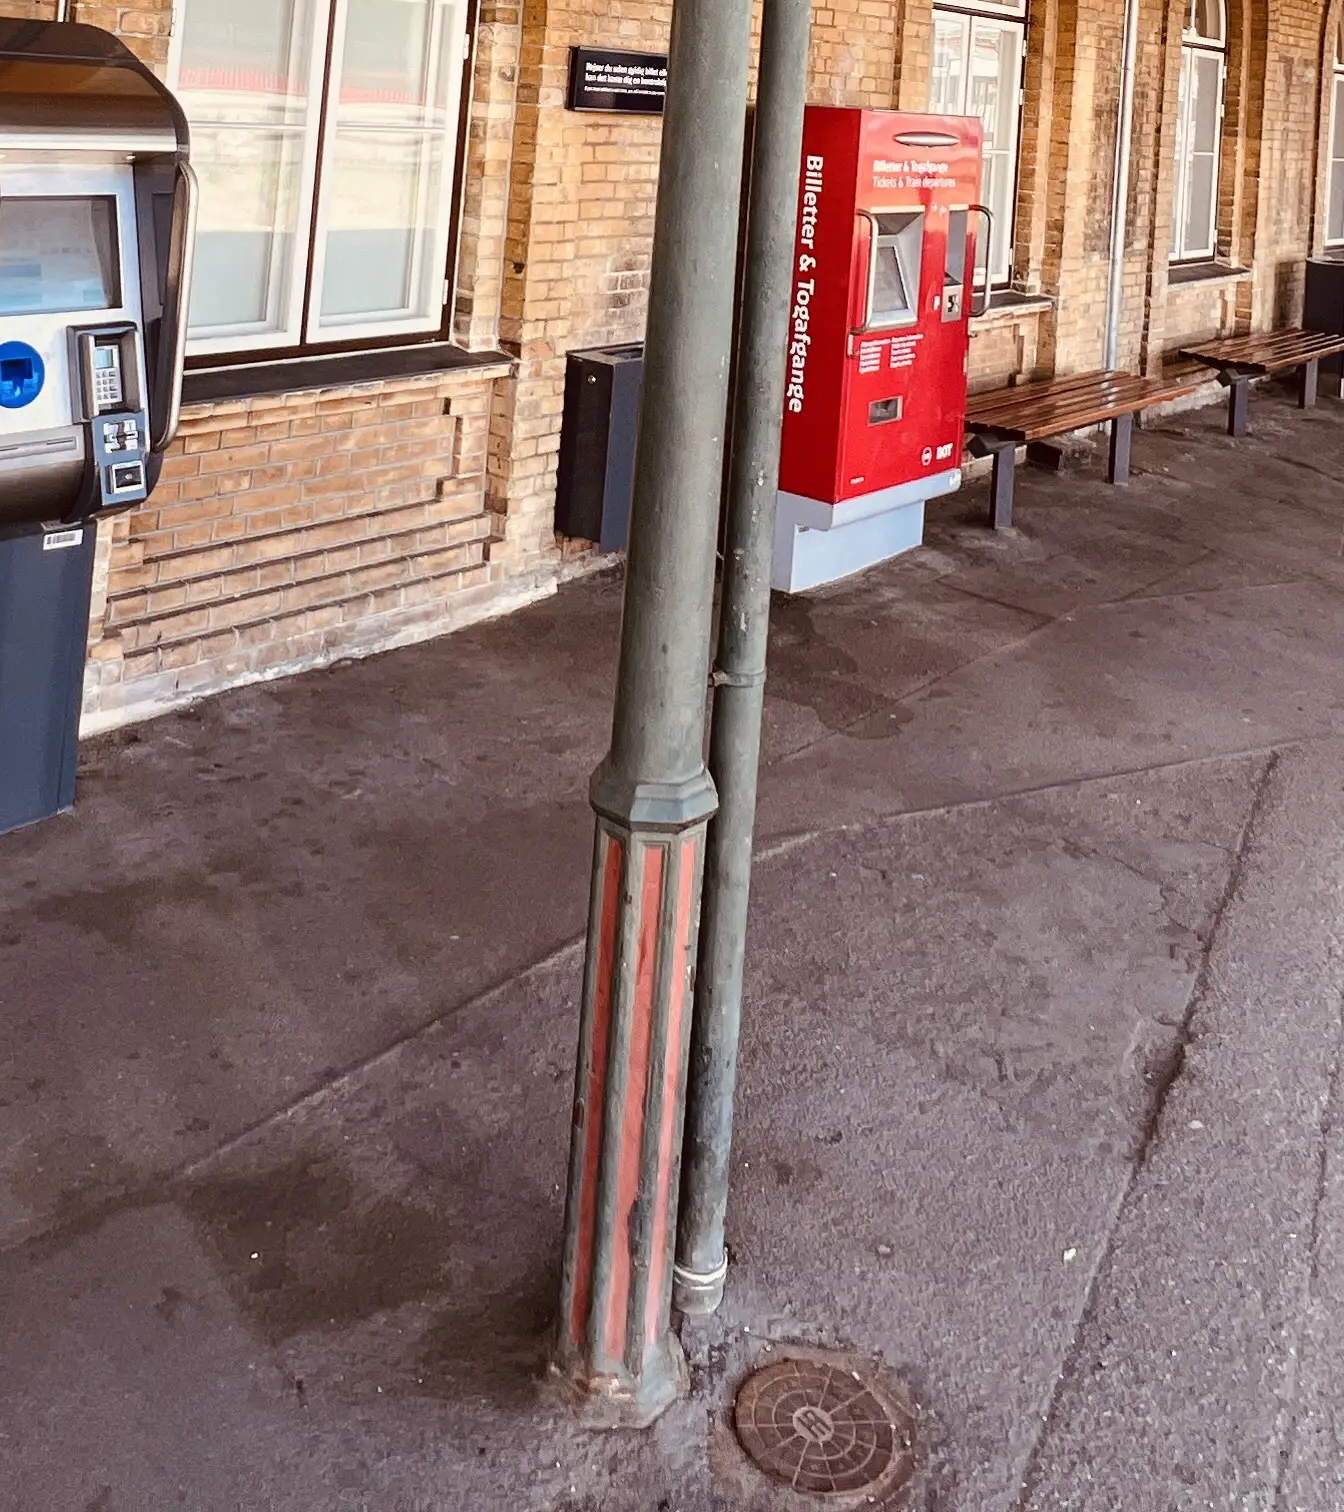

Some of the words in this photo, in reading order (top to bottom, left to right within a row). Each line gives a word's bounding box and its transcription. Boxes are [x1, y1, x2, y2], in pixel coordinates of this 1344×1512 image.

[801, 155, 823, 249] Billetter
[799, 254, 816, 272] &
[787, 279, 814, 413] Togafgange
